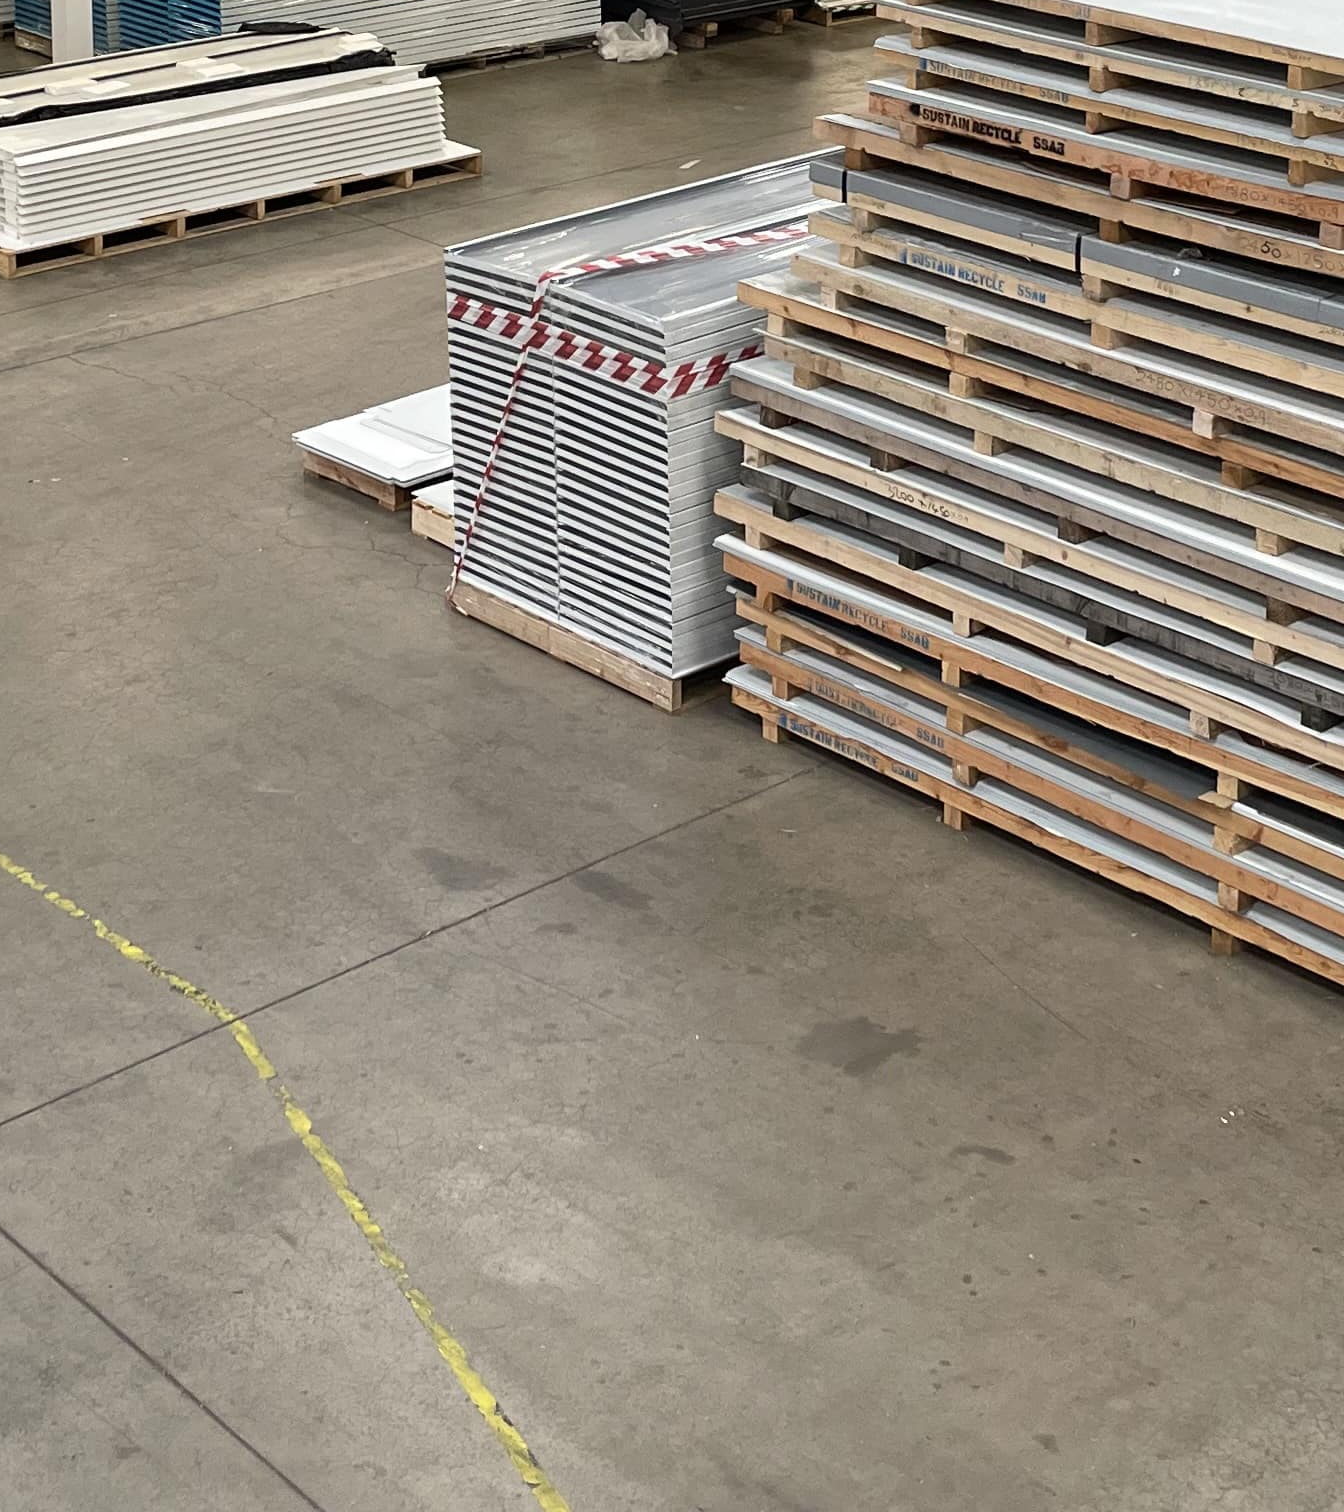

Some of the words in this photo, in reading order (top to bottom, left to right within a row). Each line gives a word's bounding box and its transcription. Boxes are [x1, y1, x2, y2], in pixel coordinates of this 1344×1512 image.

[921, 107, 971, 132] SUSTAIN
[972, 121, 1023, 145] RECYCLE
[911, 252, 956, 277] SUSTAIN
[958, 266, 1005, 293] RECYCLE
[796, 581, 841, 610] SUSTAIN
[841, 601, 889, 632] RECYCLE
